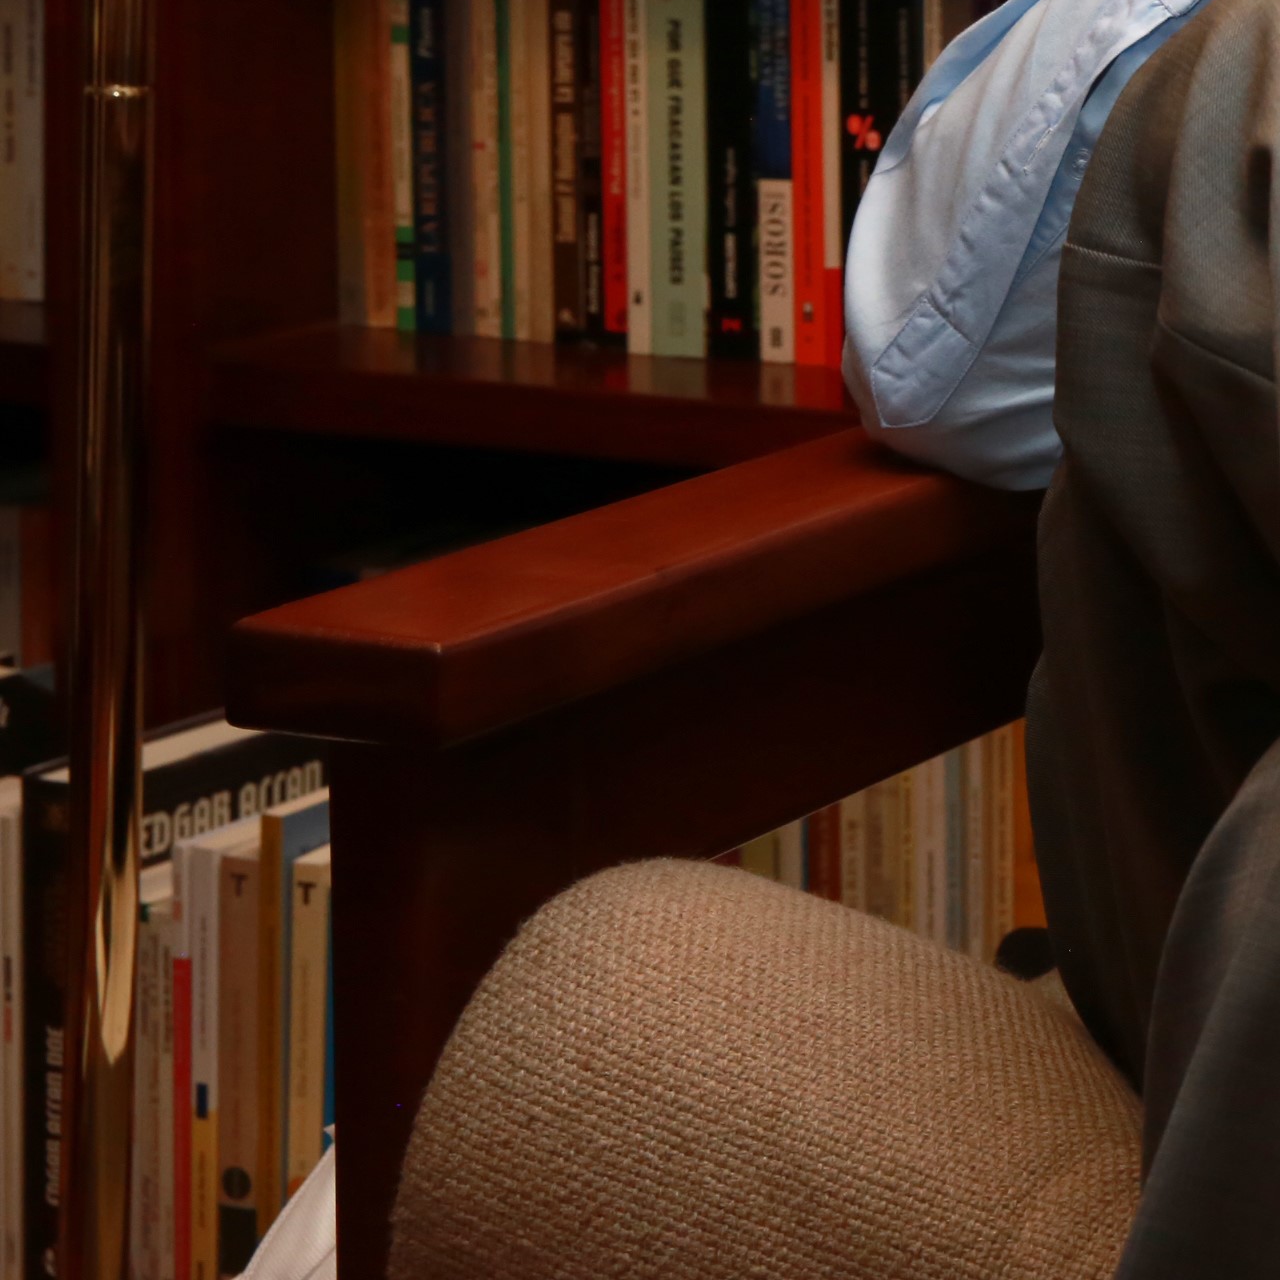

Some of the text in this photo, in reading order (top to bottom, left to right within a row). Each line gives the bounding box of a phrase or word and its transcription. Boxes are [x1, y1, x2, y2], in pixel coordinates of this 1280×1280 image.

[667, 95, 684, 187] FRACASAN
[667, 191, 684, 222] LOS
[763, 201, 787, 298] SOROS
[142, 790, 233, 858] EDGAR
